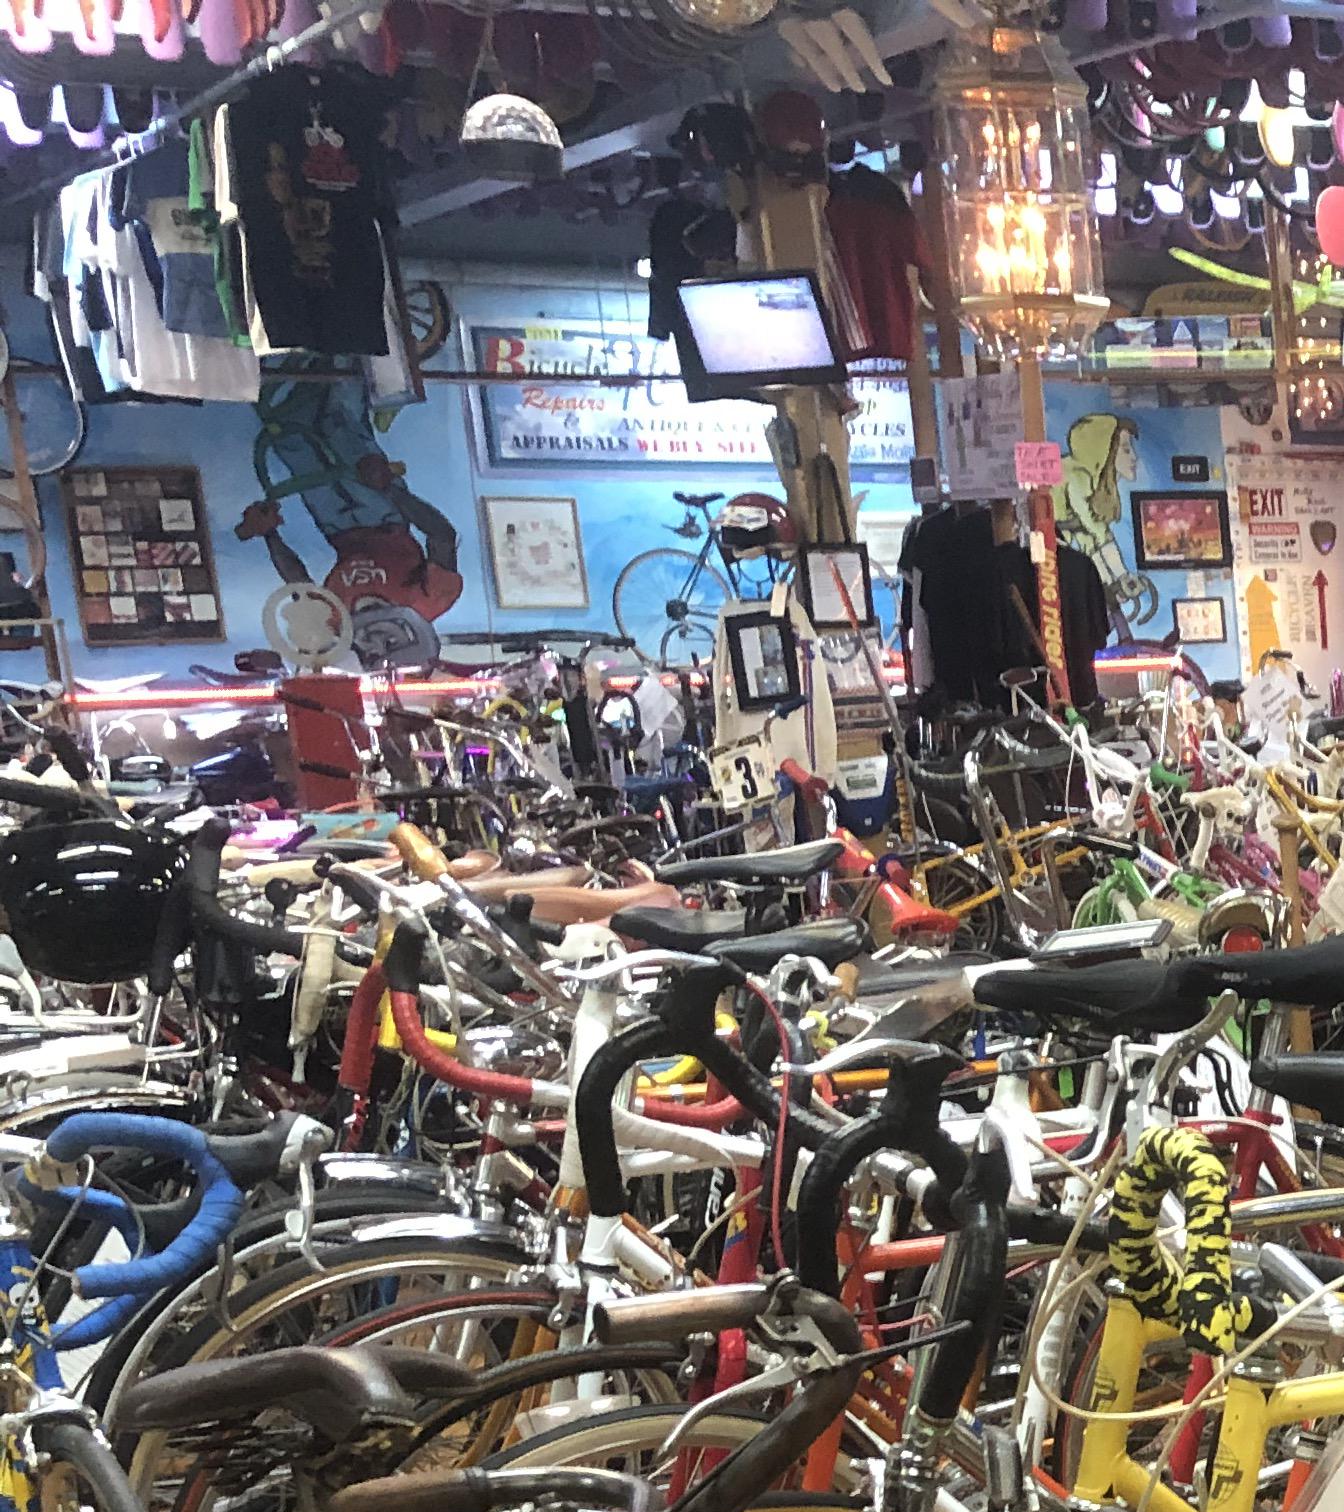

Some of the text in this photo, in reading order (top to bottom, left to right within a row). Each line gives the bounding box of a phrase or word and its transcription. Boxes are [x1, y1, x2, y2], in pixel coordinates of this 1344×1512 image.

[521, 385, 605, 412] Repairs
[511, 434, 630, 452] APPRAISALS
[1250, 488, 1285, 518] EXIT
[735, 755, 759, 800] 3
